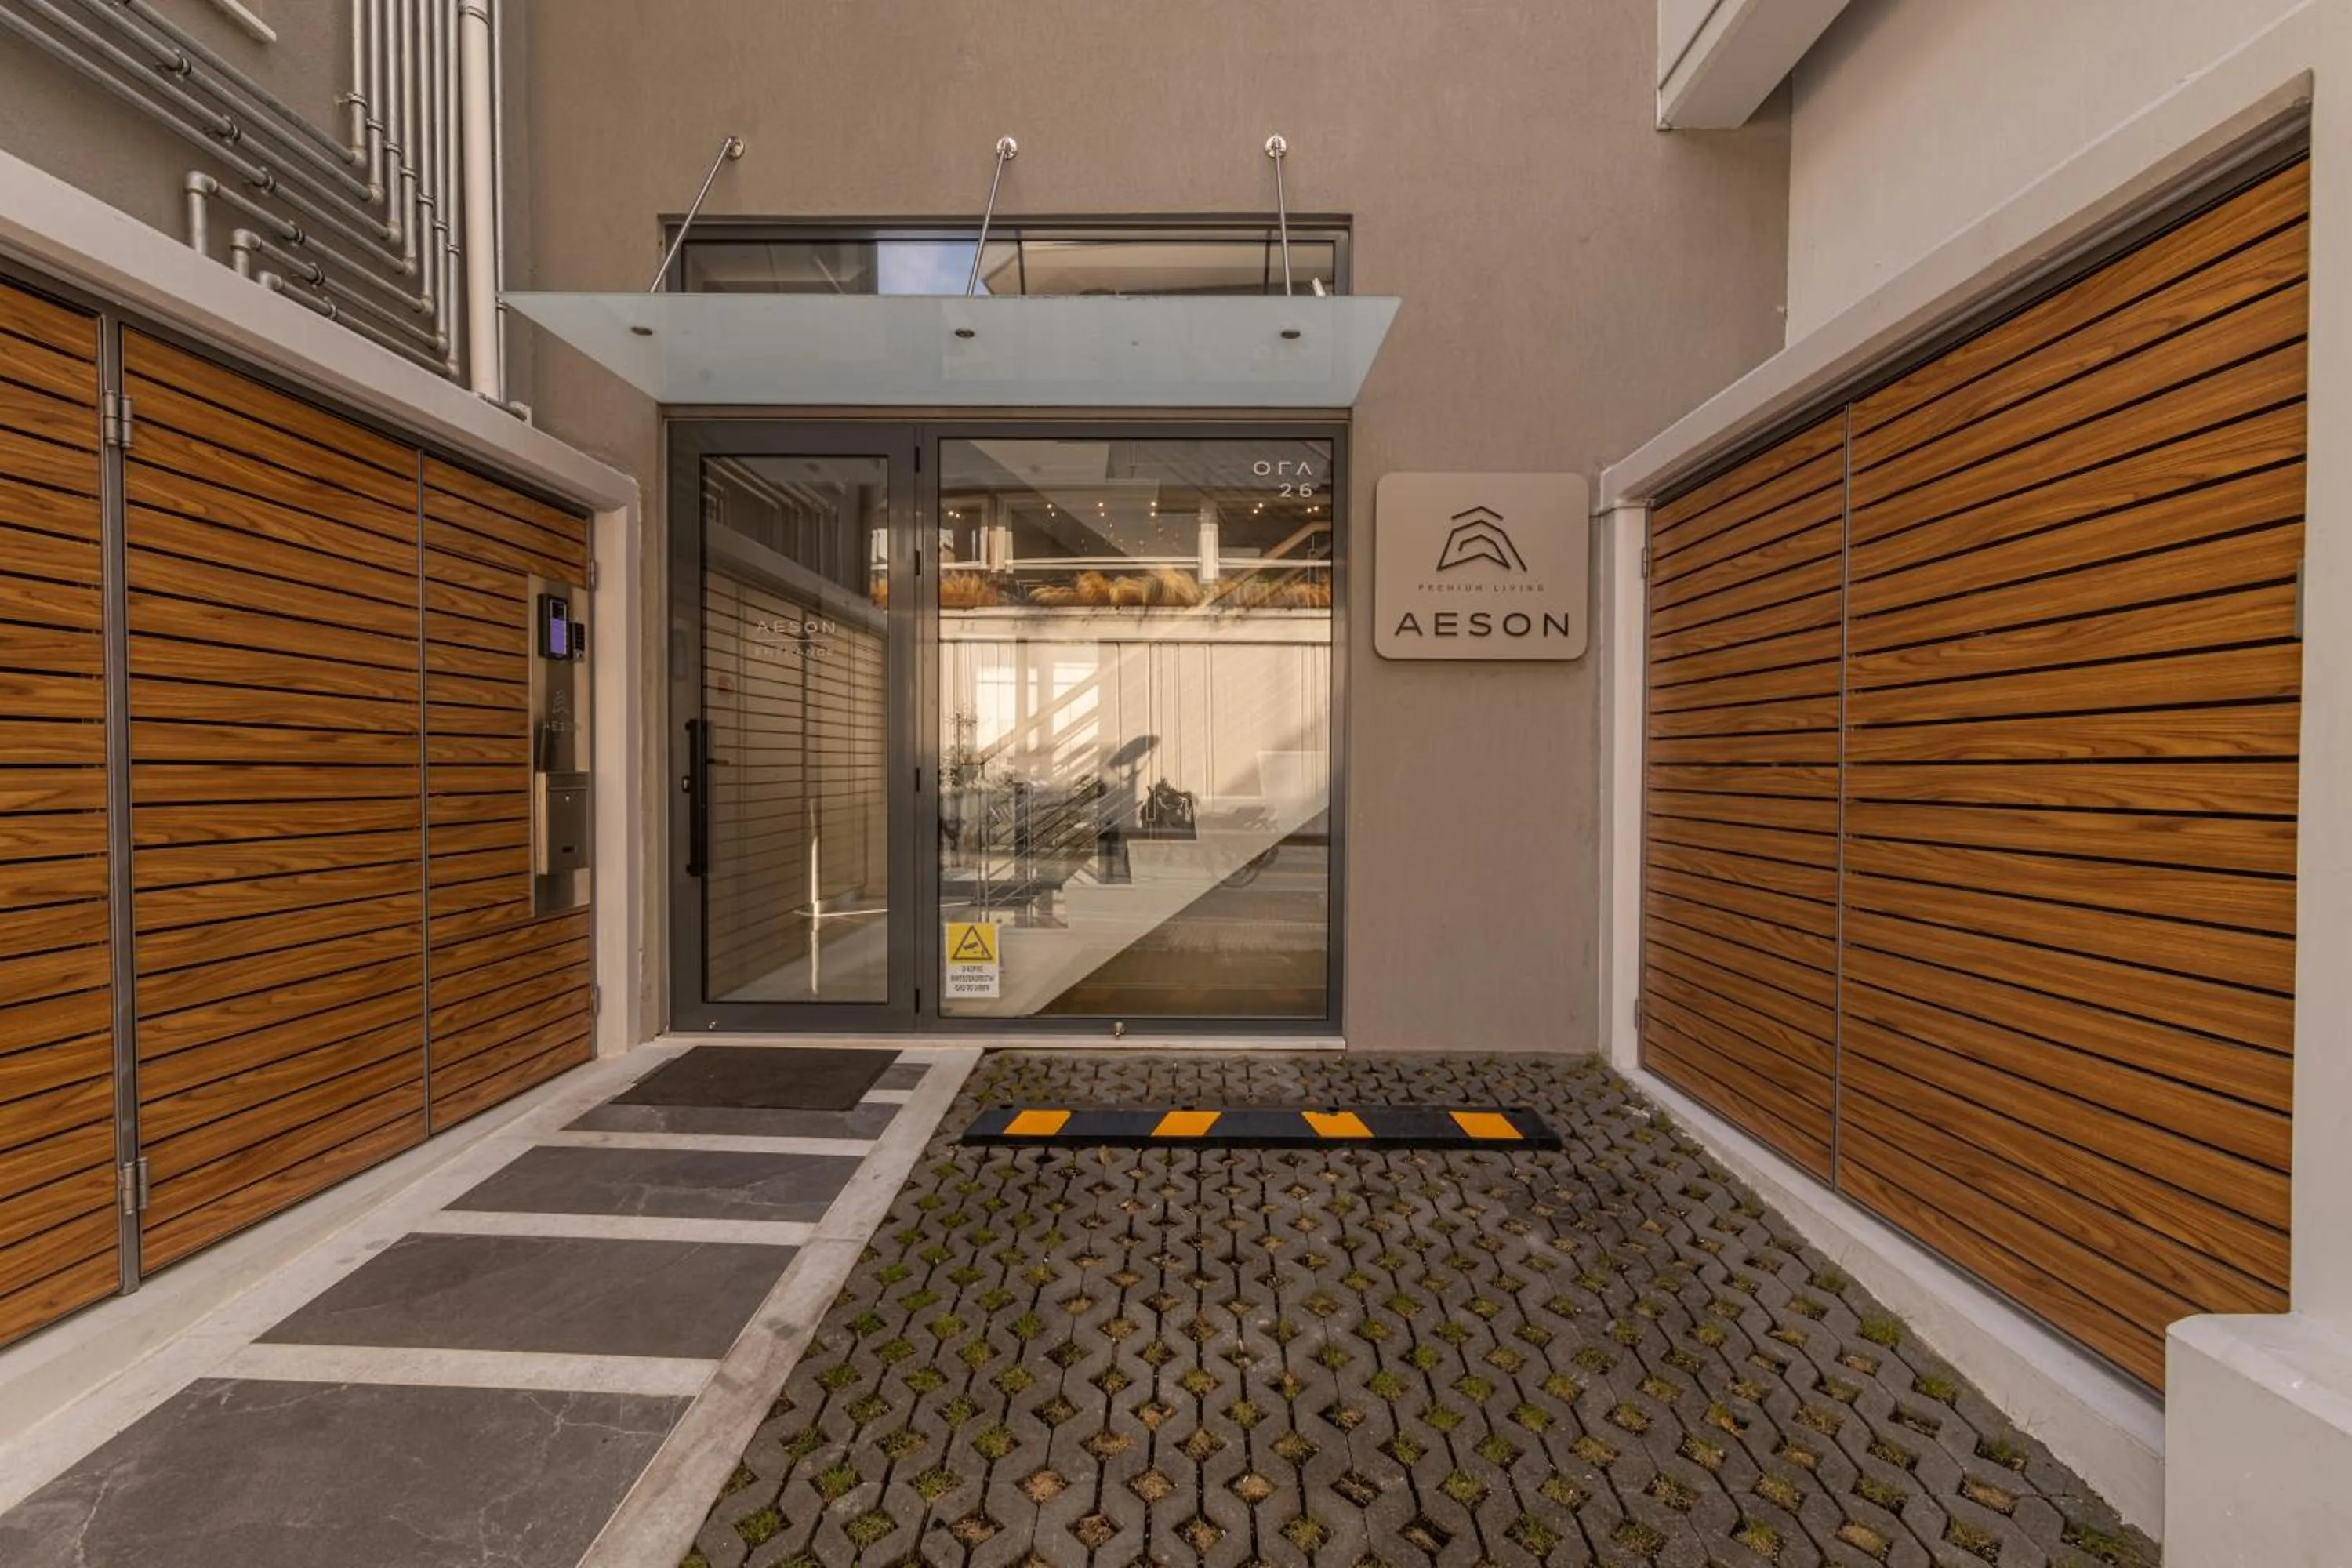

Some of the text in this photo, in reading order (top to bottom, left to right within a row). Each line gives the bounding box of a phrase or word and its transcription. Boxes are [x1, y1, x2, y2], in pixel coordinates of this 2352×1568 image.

[1279, 482, 1313, 499] 26
[1417, 583, 1544, 592] PREMIUM LIVING
[756, 619, 836, 634] AESON
[1394, 612, 1570, 637] AESON
[754, 647, 833, 657] ENTANCE
